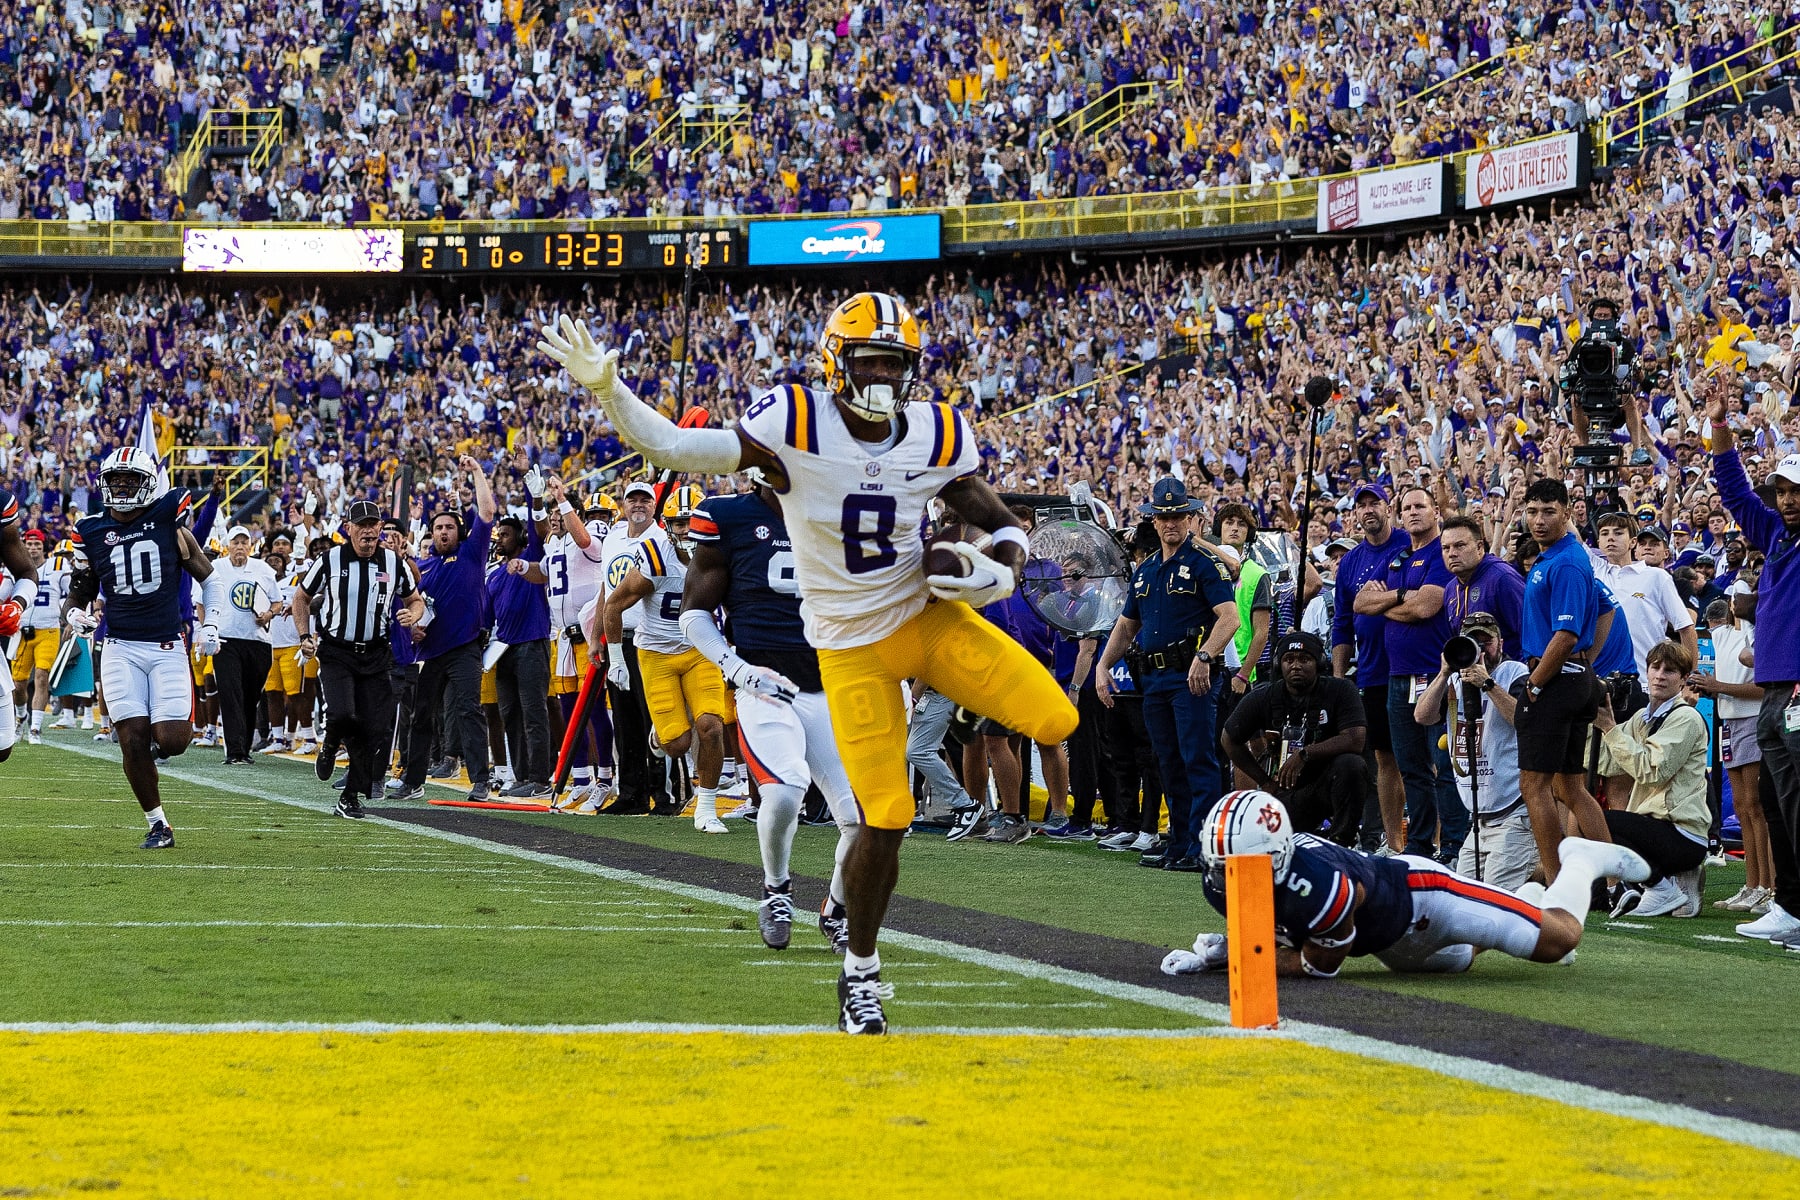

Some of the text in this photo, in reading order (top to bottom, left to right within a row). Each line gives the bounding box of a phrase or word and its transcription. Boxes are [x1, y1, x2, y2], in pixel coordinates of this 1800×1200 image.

[1498, 139, 1567, 165] OFFICIAL CATERING SERVICE OF
[1497, 165, 1515, 193] LSU
[1518, 154, 1568, 189] ATHLETICS
[1369, 177, 1432, 199] AUTO HOME LIFE
[422, 248, 434, 269] 2
[456, 248, 468, 268] 7
[491, 248, 503, 269] 0
[545, 233, 623, 267] 13:23
[664, 245, 676, 266] 0
[723, 244, 730, 264] 1
[479, 236, 501, 247] LSU
[648, 233, 681, 245] VISITOR
[746, 393, 776, 420] 8
[860, 483, 883, 491] LSU
[841, 493, 898, 575] 8
[109, 539, 162, 595] 10
[341, 569, 349, 577] S
[546, 553, 569, 598] 13
[34, 580, 50, 606] 5
[377, 593, 387, 604] H
[1286, 871, 1313, 897] 5
